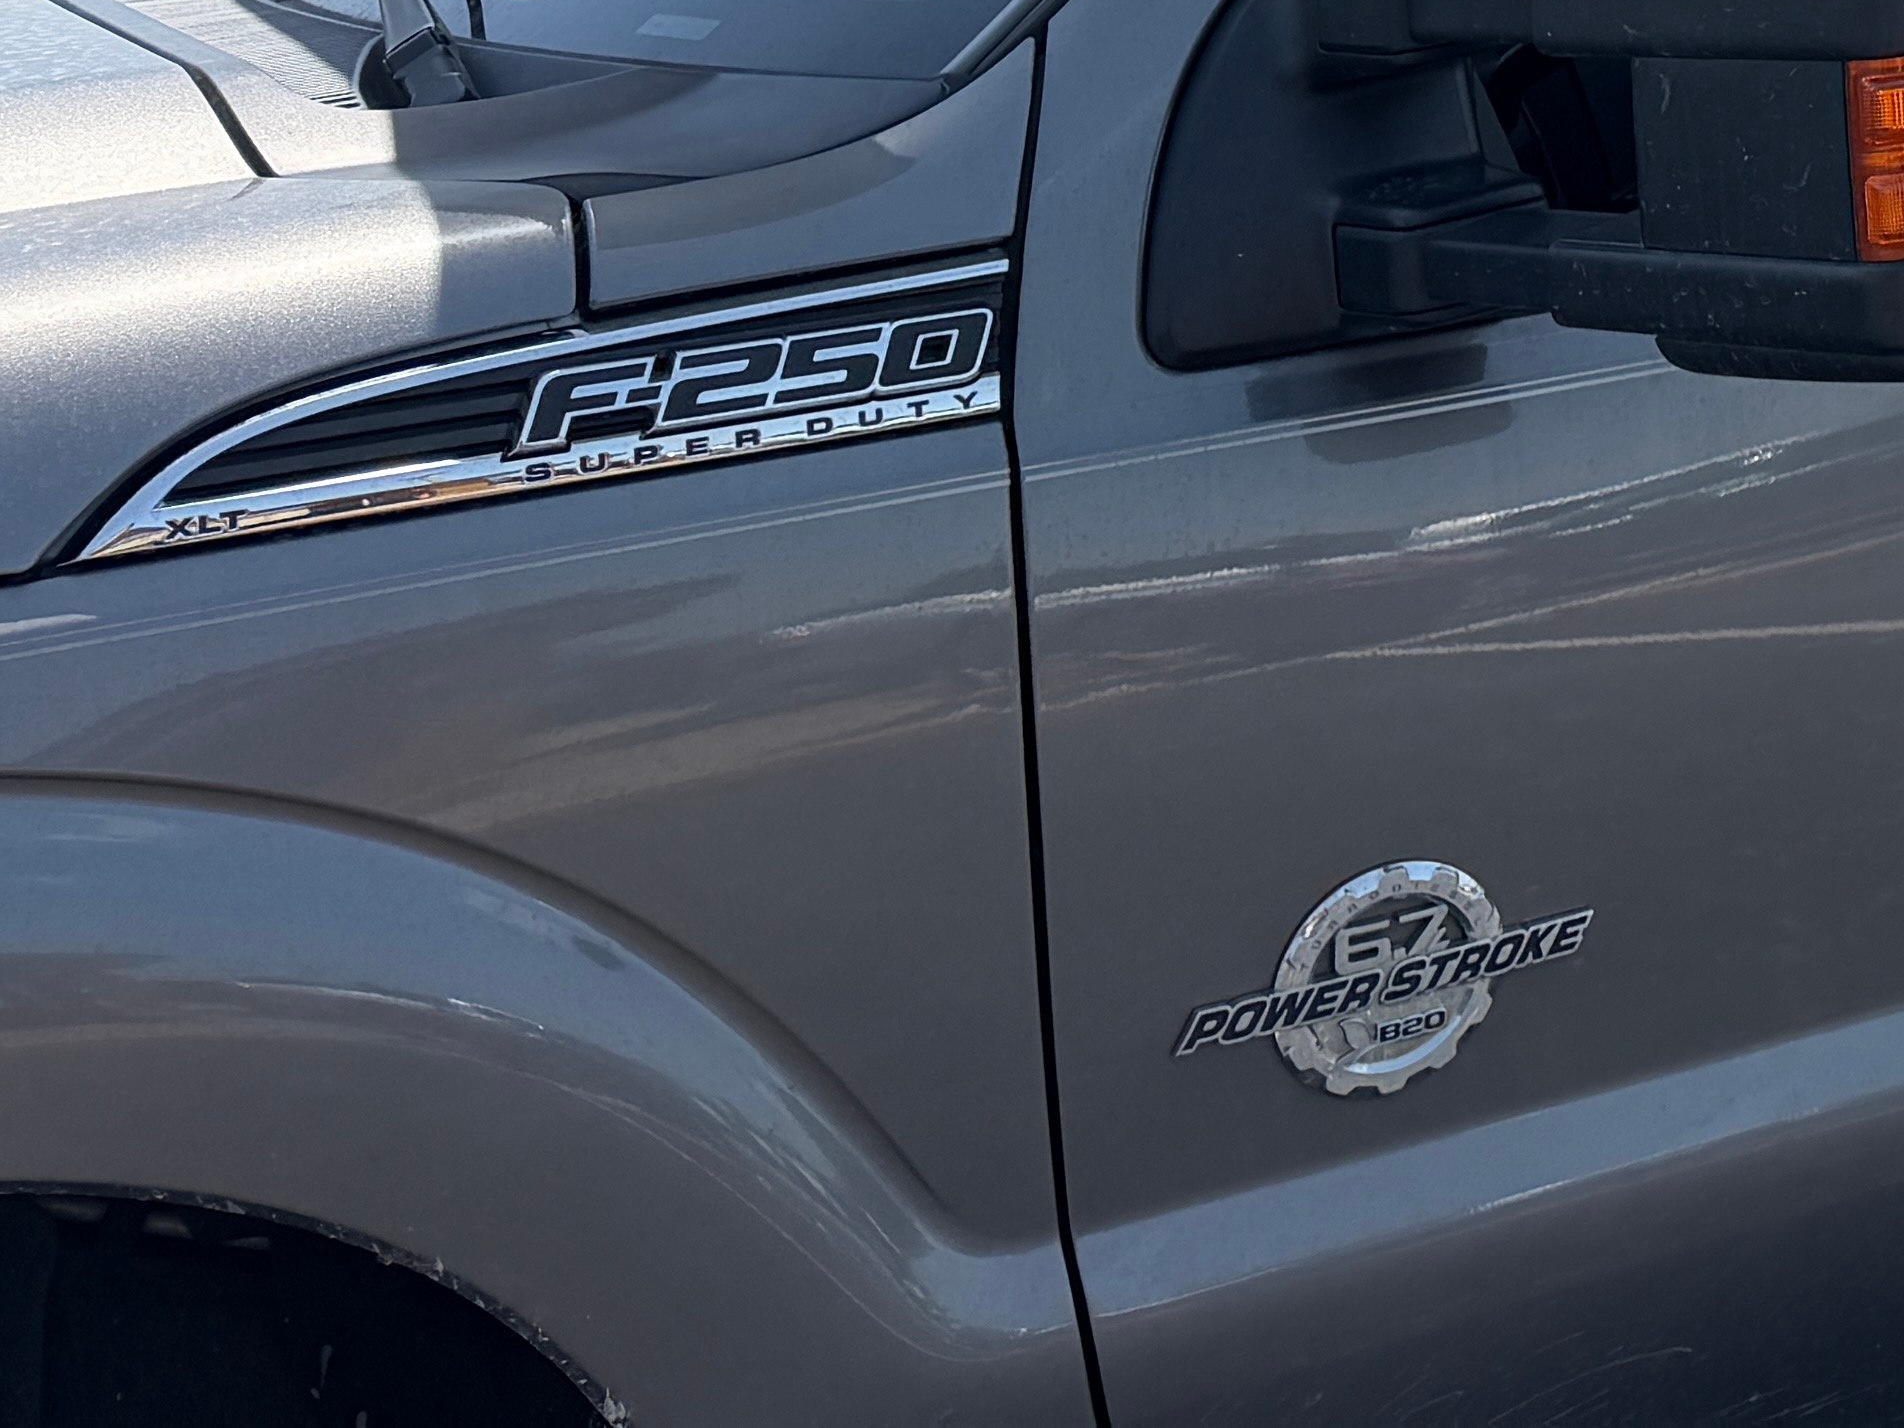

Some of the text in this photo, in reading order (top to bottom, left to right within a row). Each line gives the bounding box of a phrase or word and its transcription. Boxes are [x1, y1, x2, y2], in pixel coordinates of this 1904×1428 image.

[512, 307, 993, 458] F-250
[521, 390, 980, 484] SUPER DUTY
[163, 510, 249, 543] XLT
[1174, 909, 1595, 1056] POWER STROKE
[1376, 1010, 1447, 1044] B20
